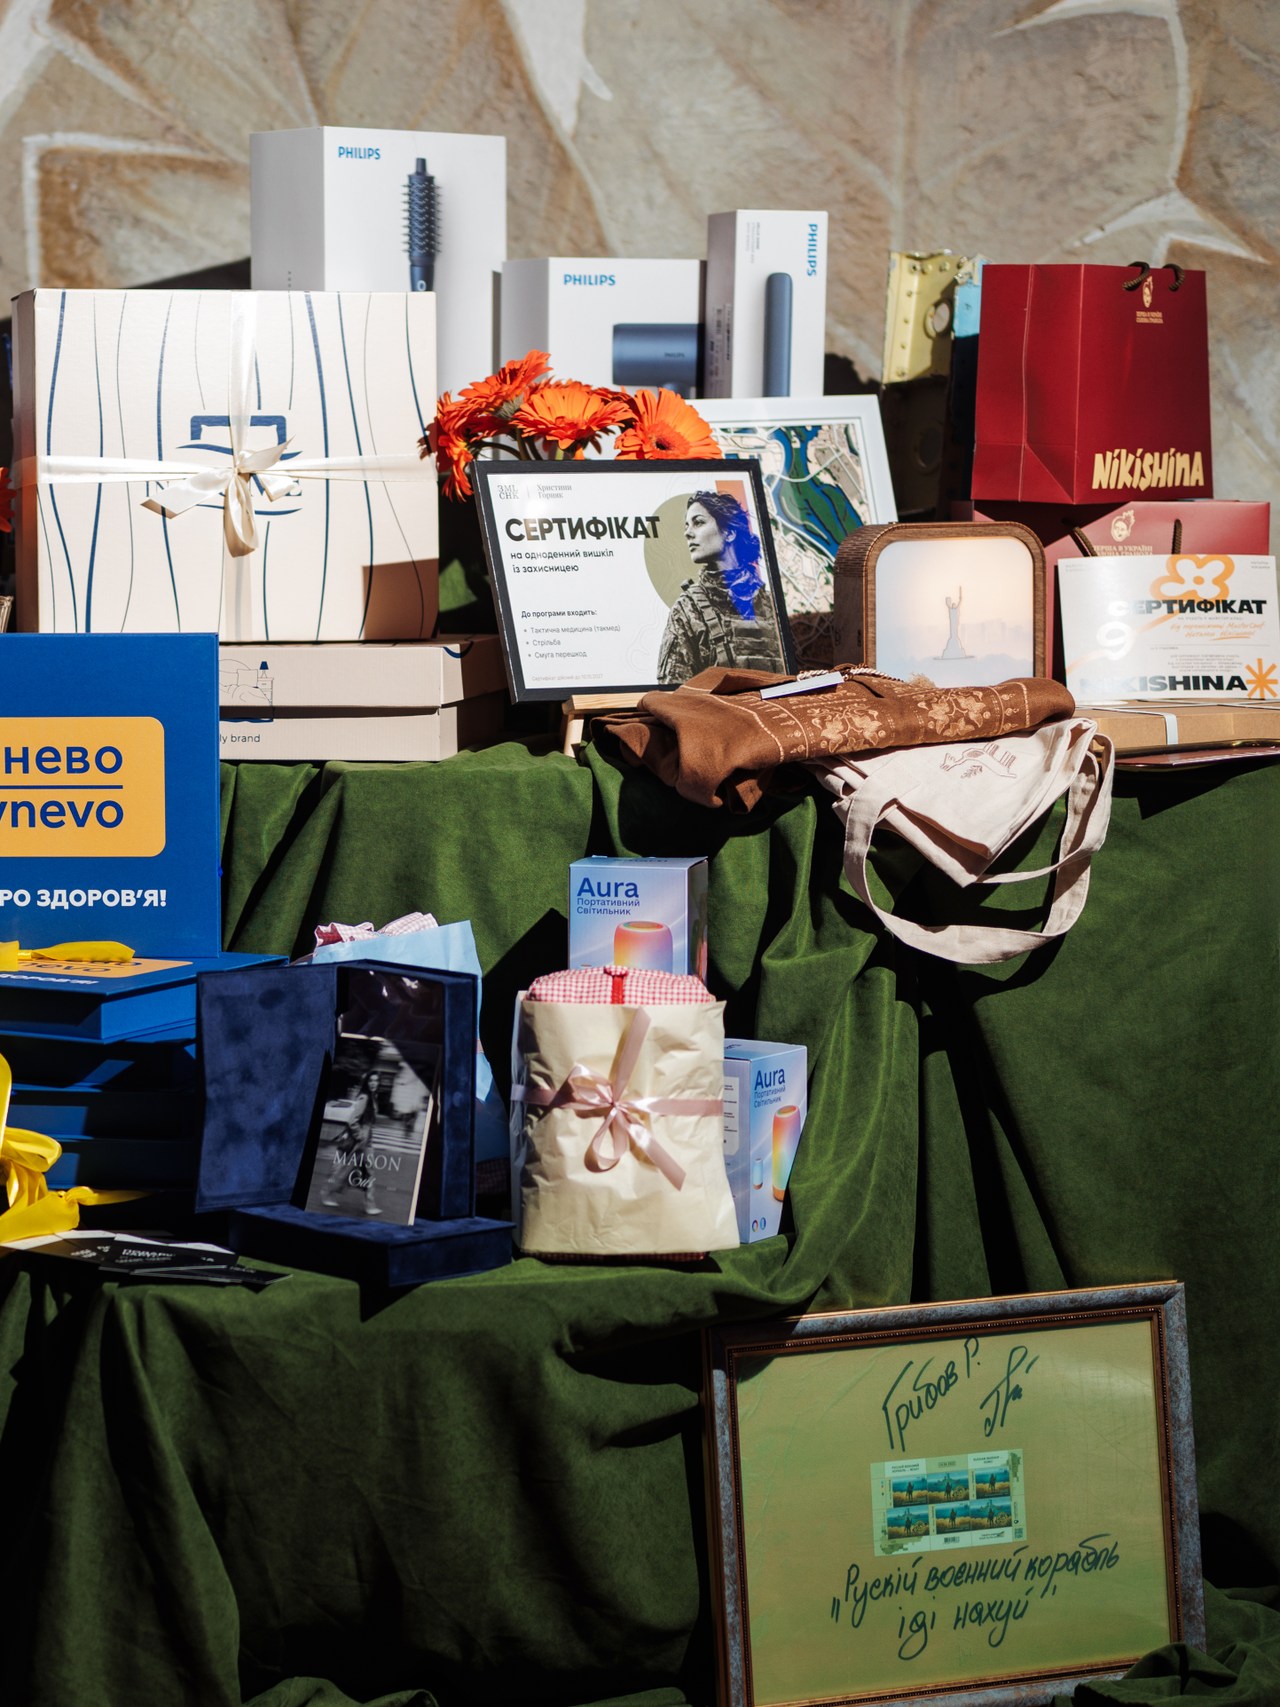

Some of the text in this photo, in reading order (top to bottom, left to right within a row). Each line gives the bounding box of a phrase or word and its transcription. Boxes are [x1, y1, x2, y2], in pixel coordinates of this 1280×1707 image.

[338, 146, 381, 160] PHILIPS
[807, 223, 818, 277] PHILIPS
[563, 274, 617, 286] PHILIPS
[505, 516, 660, 542] СЕРТИФІКАТ
[510, 548, 614, 560] на одноденний вишкіл
[512, 564, 579, 574] із захисницею
[521, 609, 597, 619] До програми входить:
[532, 639, 561, 647] Стрільба
[534, 650, 588, 660] Смуга перешкод
[230, 733, 261, 743] brand
[576, 877, 639, 898] Aura
[577, 898, 640, 907] Портативний
[576, 906, 631, 915] Світильник
[754, 1068, 786, 1091] Aura
[754, 1085, 786, 1099] Портативний
[333, 1150, 402, 1172] MAISON
